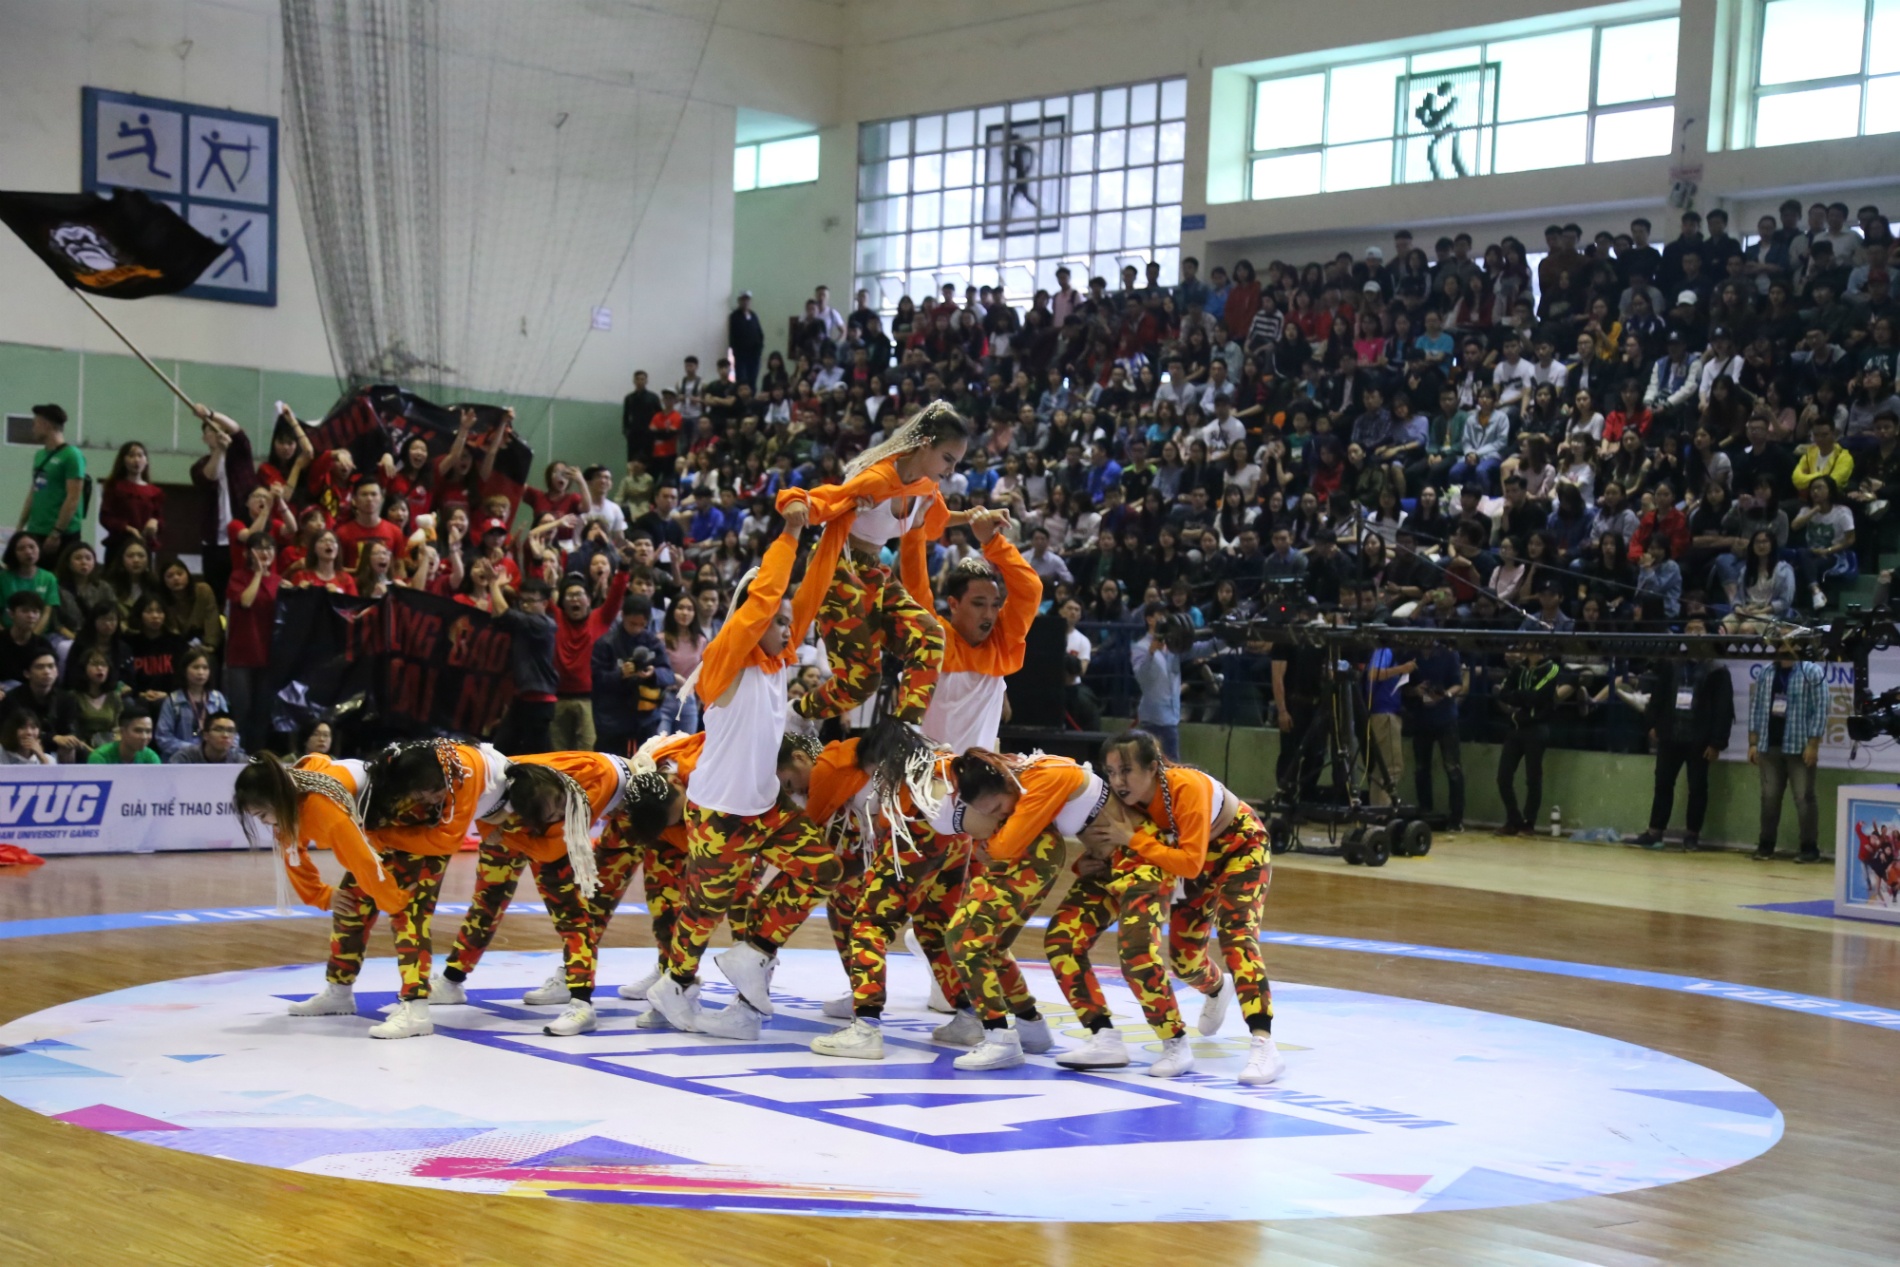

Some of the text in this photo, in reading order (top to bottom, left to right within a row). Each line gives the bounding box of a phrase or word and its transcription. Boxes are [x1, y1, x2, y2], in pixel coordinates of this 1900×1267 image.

[133, 654, 174, 676] PUNK
[0, 784, 101, 823] VUG
[121, 799, 147, 817] GIẢI
[151, 796, 176, 816] THỂ
[179, 802, 212, 816] THAO
[17, 830, 67, 839] UNIVERSITY
[69, 829, 99, 838] GAMES
[1682, 983, 1841, 1009] VUG
